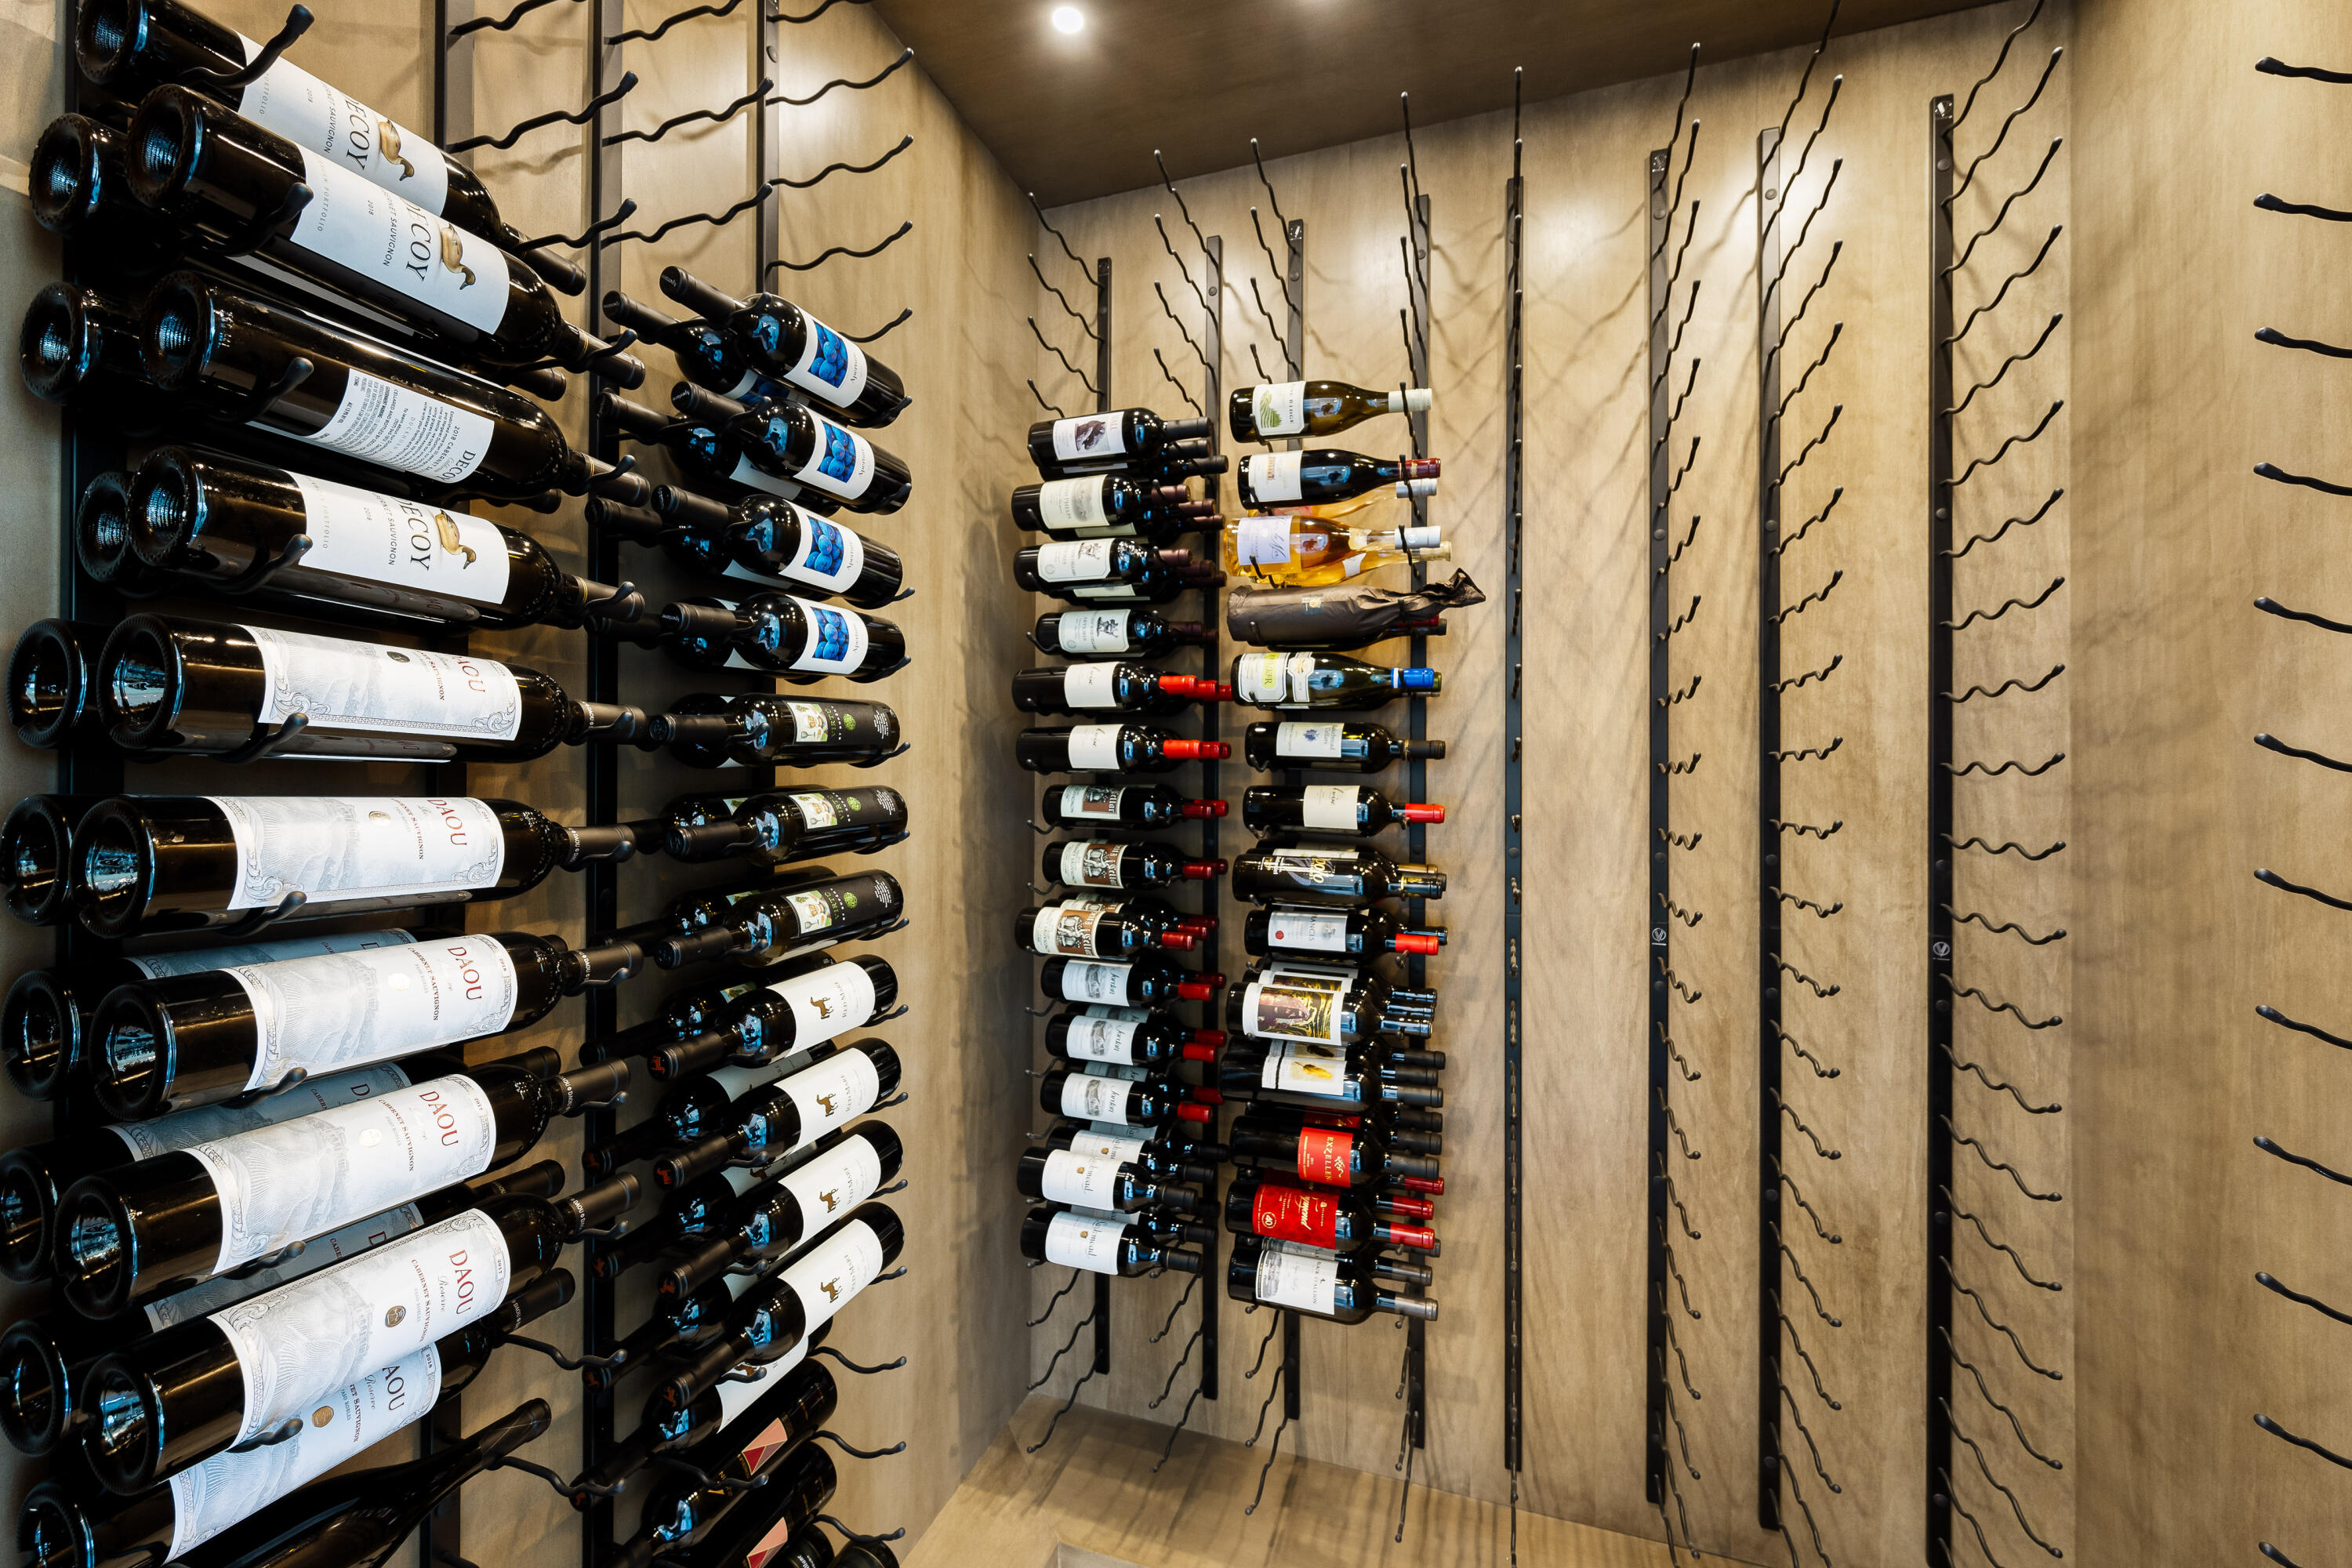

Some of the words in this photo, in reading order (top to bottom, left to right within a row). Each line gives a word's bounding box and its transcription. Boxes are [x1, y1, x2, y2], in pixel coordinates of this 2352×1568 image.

[323, 106, 340, 154] SAUVIGNON
[383, 216, 398, 267] SAUVIGNON
[432, 441, 454, 468] CABERNET
[451, 426, 460, 440] 2018
[435, 449, 477, 481] DECOY
[387, 517, 398, 565] SAUVIGNON
[426, 799, 468, 846] DAOU
[572, 833, 581, 848] DAOU
[1107, 863, 1120, 887] Cellar
[1083, 933, 1094, 956] Cellar
[1309, 916, 1318, 942] ANCIS
[407, 947, 434, 974] CABERNET
[430, 975, 441, 1021] SAUVIGNON
[447, 946, 483, 1000] DAOU
[378, 1098, 405, 1125] CABERNET
[402, 1126, 415, 1172] SAUVIGNON
[419, 1091, 459, 1147] DAOU
[1323, 1136, 1334, 1181] EXZELLEN
[573, 1200, 585, 1214] DAOU
[1263, 1214, 1274, 1226] 40
[411, 1259, 430, 1298] CABERNET
[449, 1249, 475, 1315] DAOU
[419, 1300, 432, 1343] SAUVIGNON
[365, 1374, 376, 1410] Reserve
[382, 1365, 406, 1410] AOU
[352, 1398, 361, 1443] SAUVIGNON
